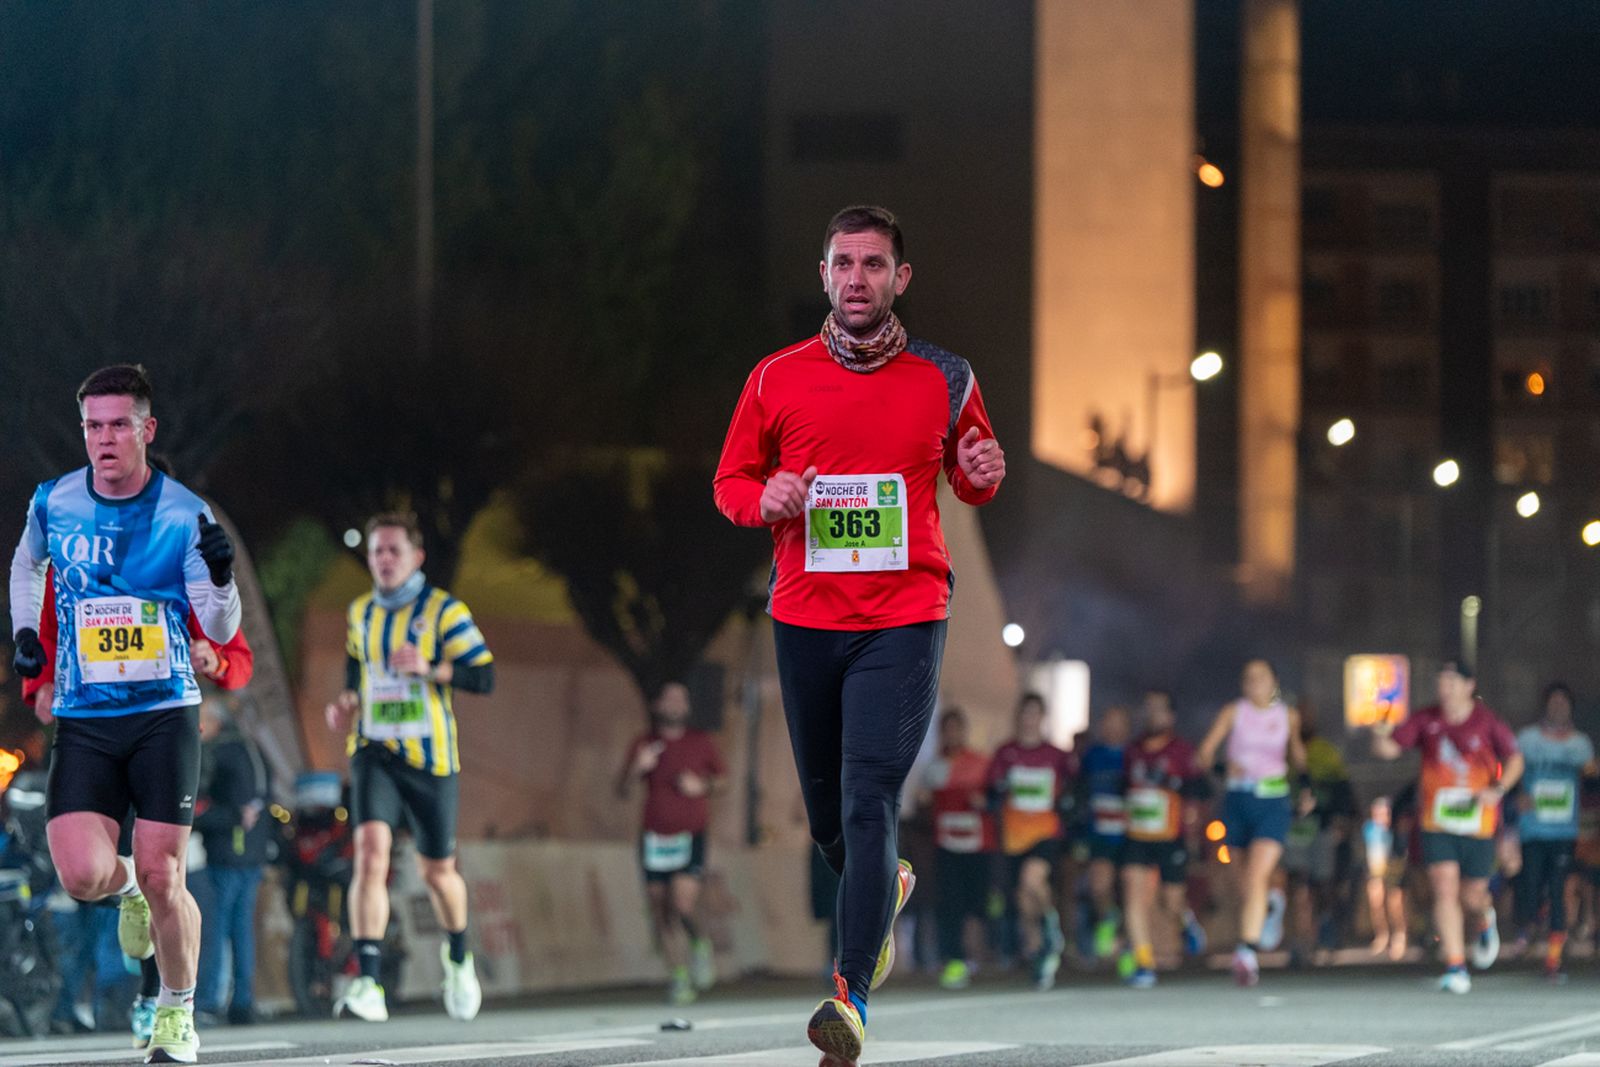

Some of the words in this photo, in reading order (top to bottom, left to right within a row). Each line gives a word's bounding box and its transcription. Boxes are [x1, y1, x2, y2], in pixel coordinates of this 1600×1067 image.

[825, 486, 854, 496] NOCHE
[856, 486, 868, 495] DE
[815, 498, 833, 508] SAN
[834, 496, 868, 508] ANTÓN
[830, 510, 880, 538] 363
[94, 606, 121, 615] NOCHE
[122, 606, 132, 614] DE
[85, 617, 102, 627] SAN
[98, 627, 144, 653] 394
